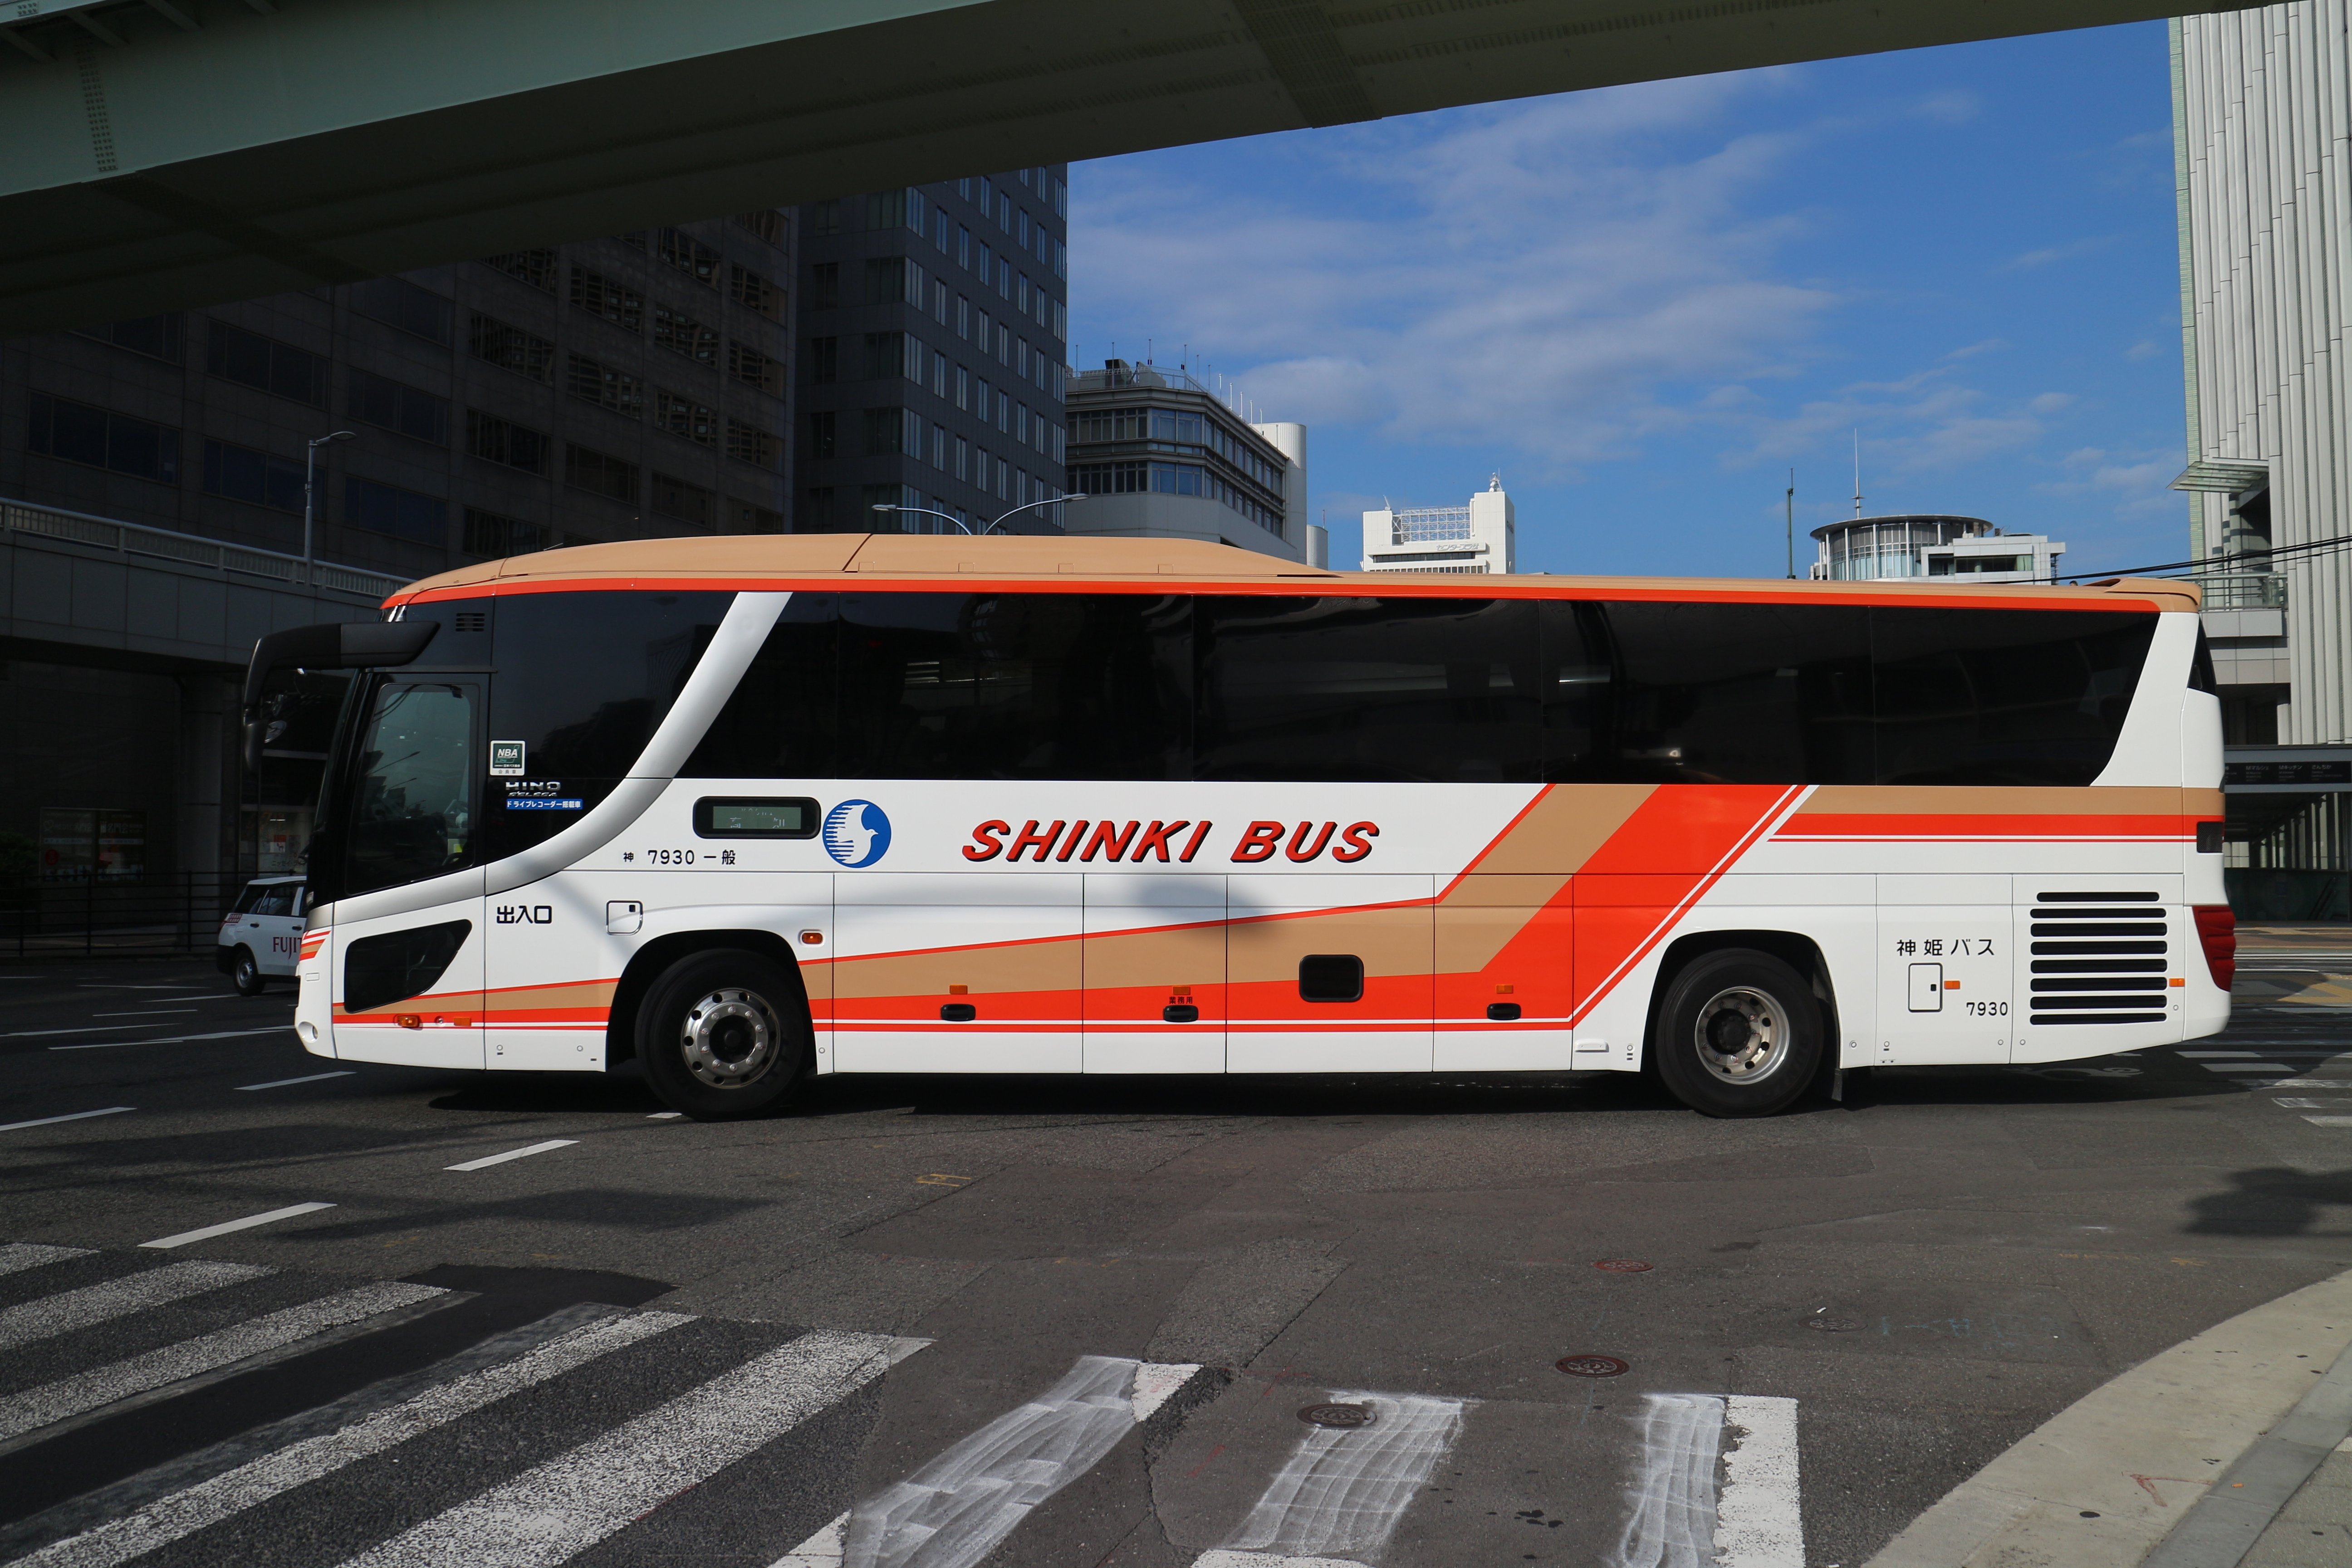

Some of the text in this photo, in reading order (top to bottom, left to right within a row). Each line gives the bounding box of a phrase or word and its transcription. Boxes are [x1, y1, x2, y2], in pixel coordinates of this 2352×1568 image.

[497, 748, 518, 756] NBA
[505, 781, 561, 791] HINO
[507, 800, 581, 808] ドライブレコーダー搭載車
[961, 819, 1379, 863] SHINKI BUS
[623, 849, 736, 865] 神 7930 一般
[497, 905, 552, 924] 出入口
[1896, 939, 1995, 956] 神姫バス
[1169, 996, 1193, 1004] 業務用
[1966, 1002, 2008, 1016] 7930
